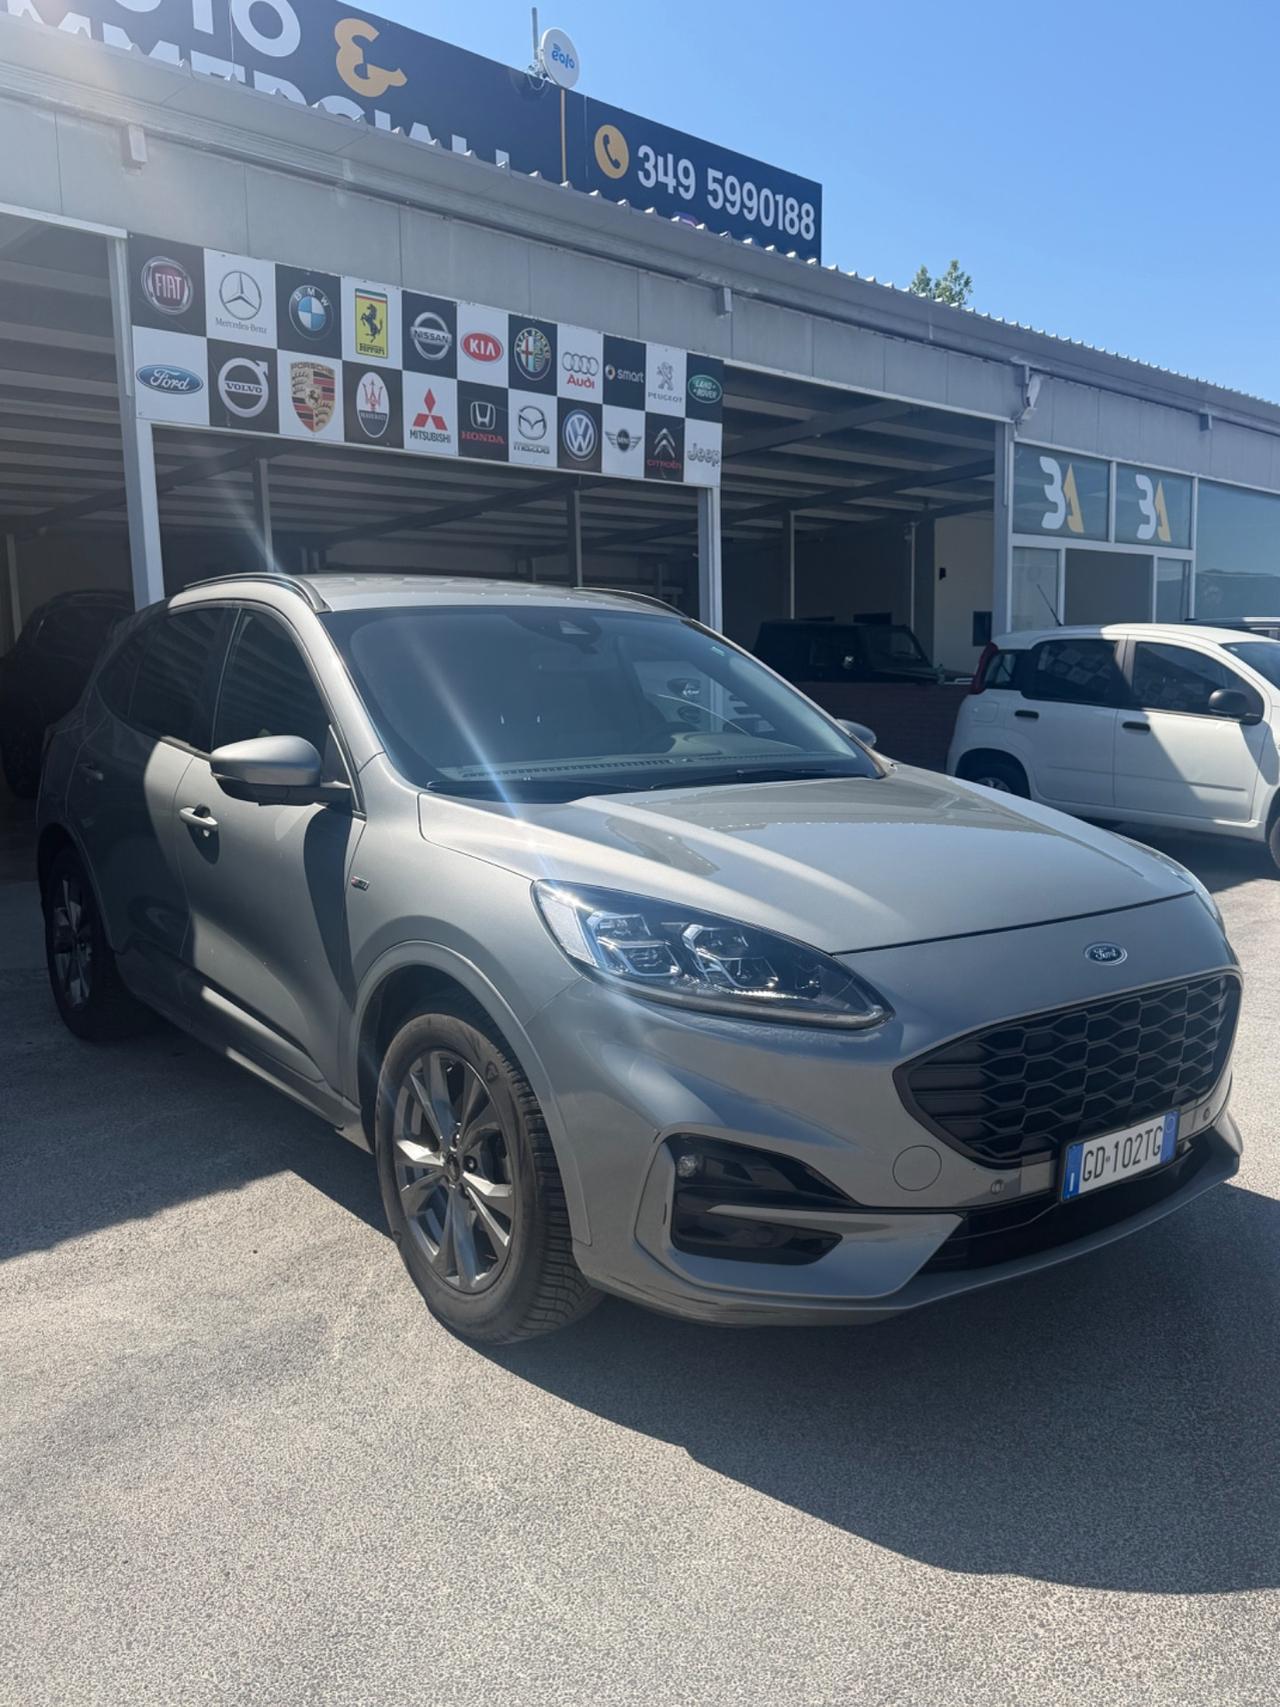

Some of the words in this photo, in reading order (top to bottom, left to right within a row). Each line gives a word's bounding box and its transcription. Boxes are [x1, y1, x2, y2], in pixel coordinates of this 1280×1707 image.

[334, 18, 408, 97] &
[638, 145, 696, 200] 349
[707, 168, 815, 240] 5990188
[155, 273, 182, 300] FIAT
[215, 317, 267, 334] Mercedes-Benz
[414, 329, 449, 344] NISSAN
[469, 338, 496, 357] KIA
[150, 367, 190, 391] Ford
[566, 373, 595, 389] Audi
[617, 369, 645, 383] smart
[224, 381, 263, 394] VOLVO
[693, 379, 713, 389] LAND
[647, 391, 683, 402] PEUGEOT
[695, 388, 719, 399] ROVER
[409, 429, 452, 444] MITSUBISHI
[461, 431, 505, 444] HONDA
[687, 442, 721, 467] Jeep
